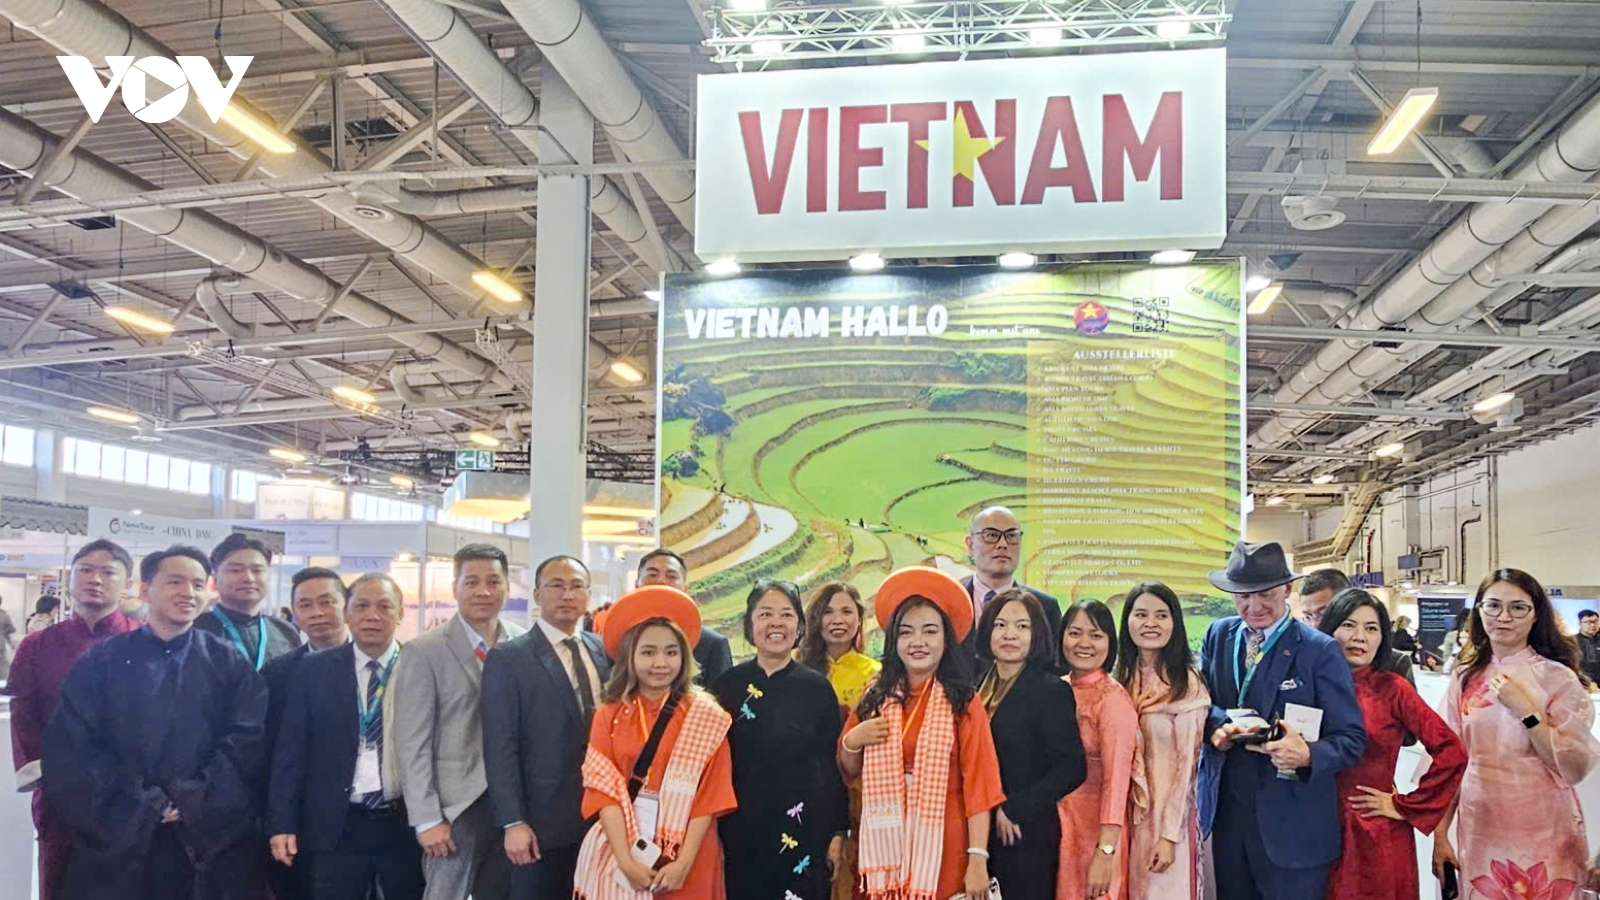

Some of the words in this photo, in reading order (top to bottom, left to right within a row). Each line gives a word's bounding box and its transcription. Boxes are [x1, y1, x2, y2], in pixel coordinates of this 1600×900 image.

[738, 91, 1183, 214] VIETNAM
[684, 307, 830, 339] VIETNAM
[841, 304, 949, 337] HALLO
[1072, 349, 1176, 360] AUSSTELLERLISTE
